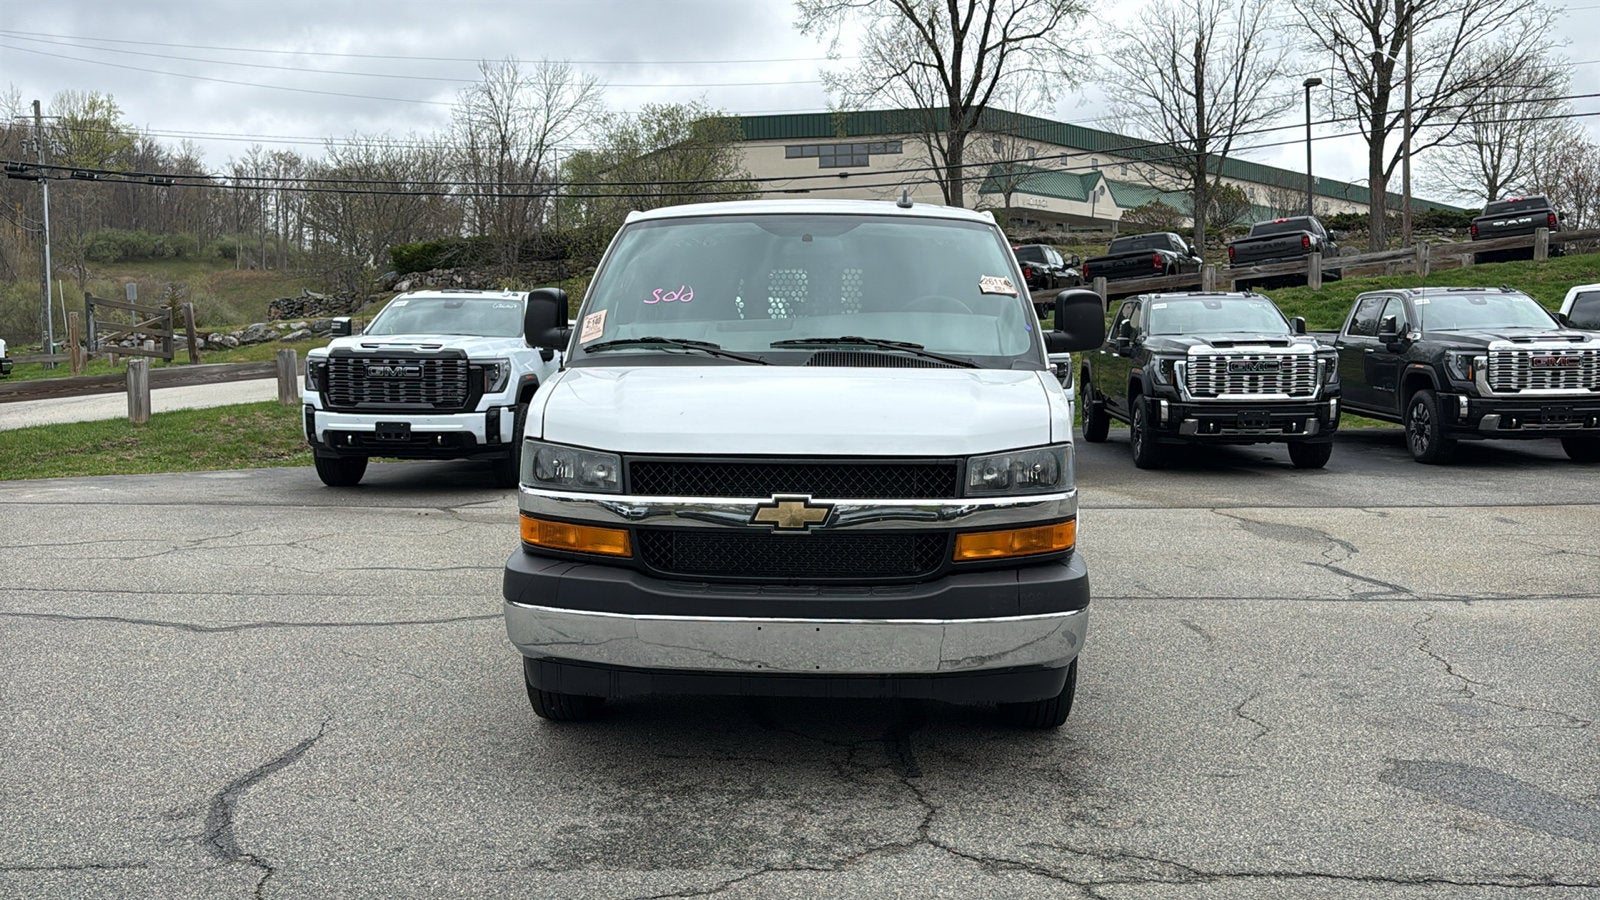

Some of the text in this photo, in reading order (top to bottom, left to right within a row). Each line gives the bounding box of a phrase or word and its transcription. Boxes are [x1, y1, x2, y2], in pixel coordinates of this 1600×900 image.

[1230, 361, 1279, 371] GMC
[1530, 356, 1580, 367] GMC
[367, 366, 420, 377] GMC
